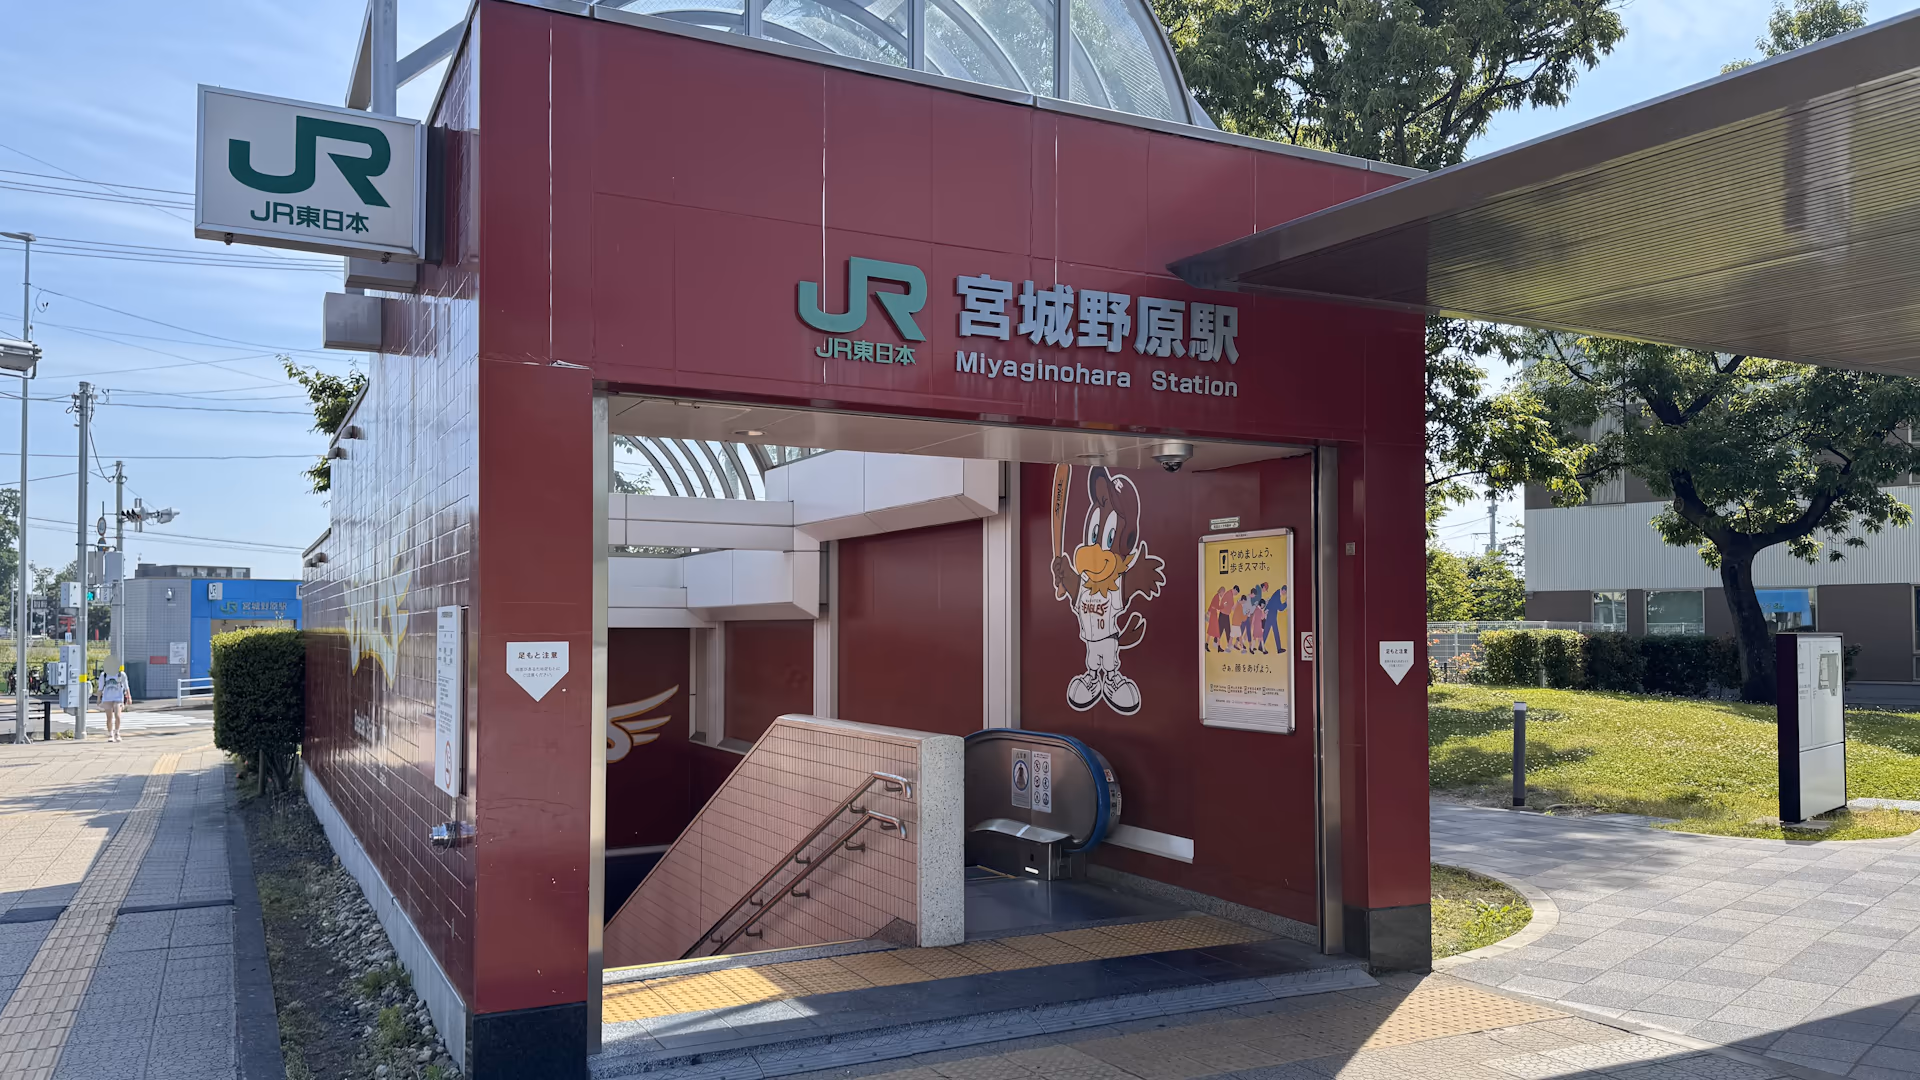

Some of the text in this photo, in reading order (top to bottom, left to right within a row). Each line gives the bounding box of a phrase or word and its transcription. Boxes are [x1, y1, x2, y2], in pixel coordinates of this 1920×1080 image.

[228, 115, 391, 208] JR
[250, 201, 369, 234] JR東日本
[797, 256, 928, 342] JR
[956, 273, 1239, 365] 宮城野原駅
[815, 337, 917, 366] JR東日本
[955, 350, 1239, 397] Miyaginohara Station
[1230, 547, 1273, 560] やめましょう、
[1230, 561, 1271, 573] 歩きスマホ。
[220, 601, 238, 614] JR
[1083, 602, 1106, 616] EAGLES
[1097, 618, 1105, 630] 10
[518, 651, 558, 660] 足もと注意
